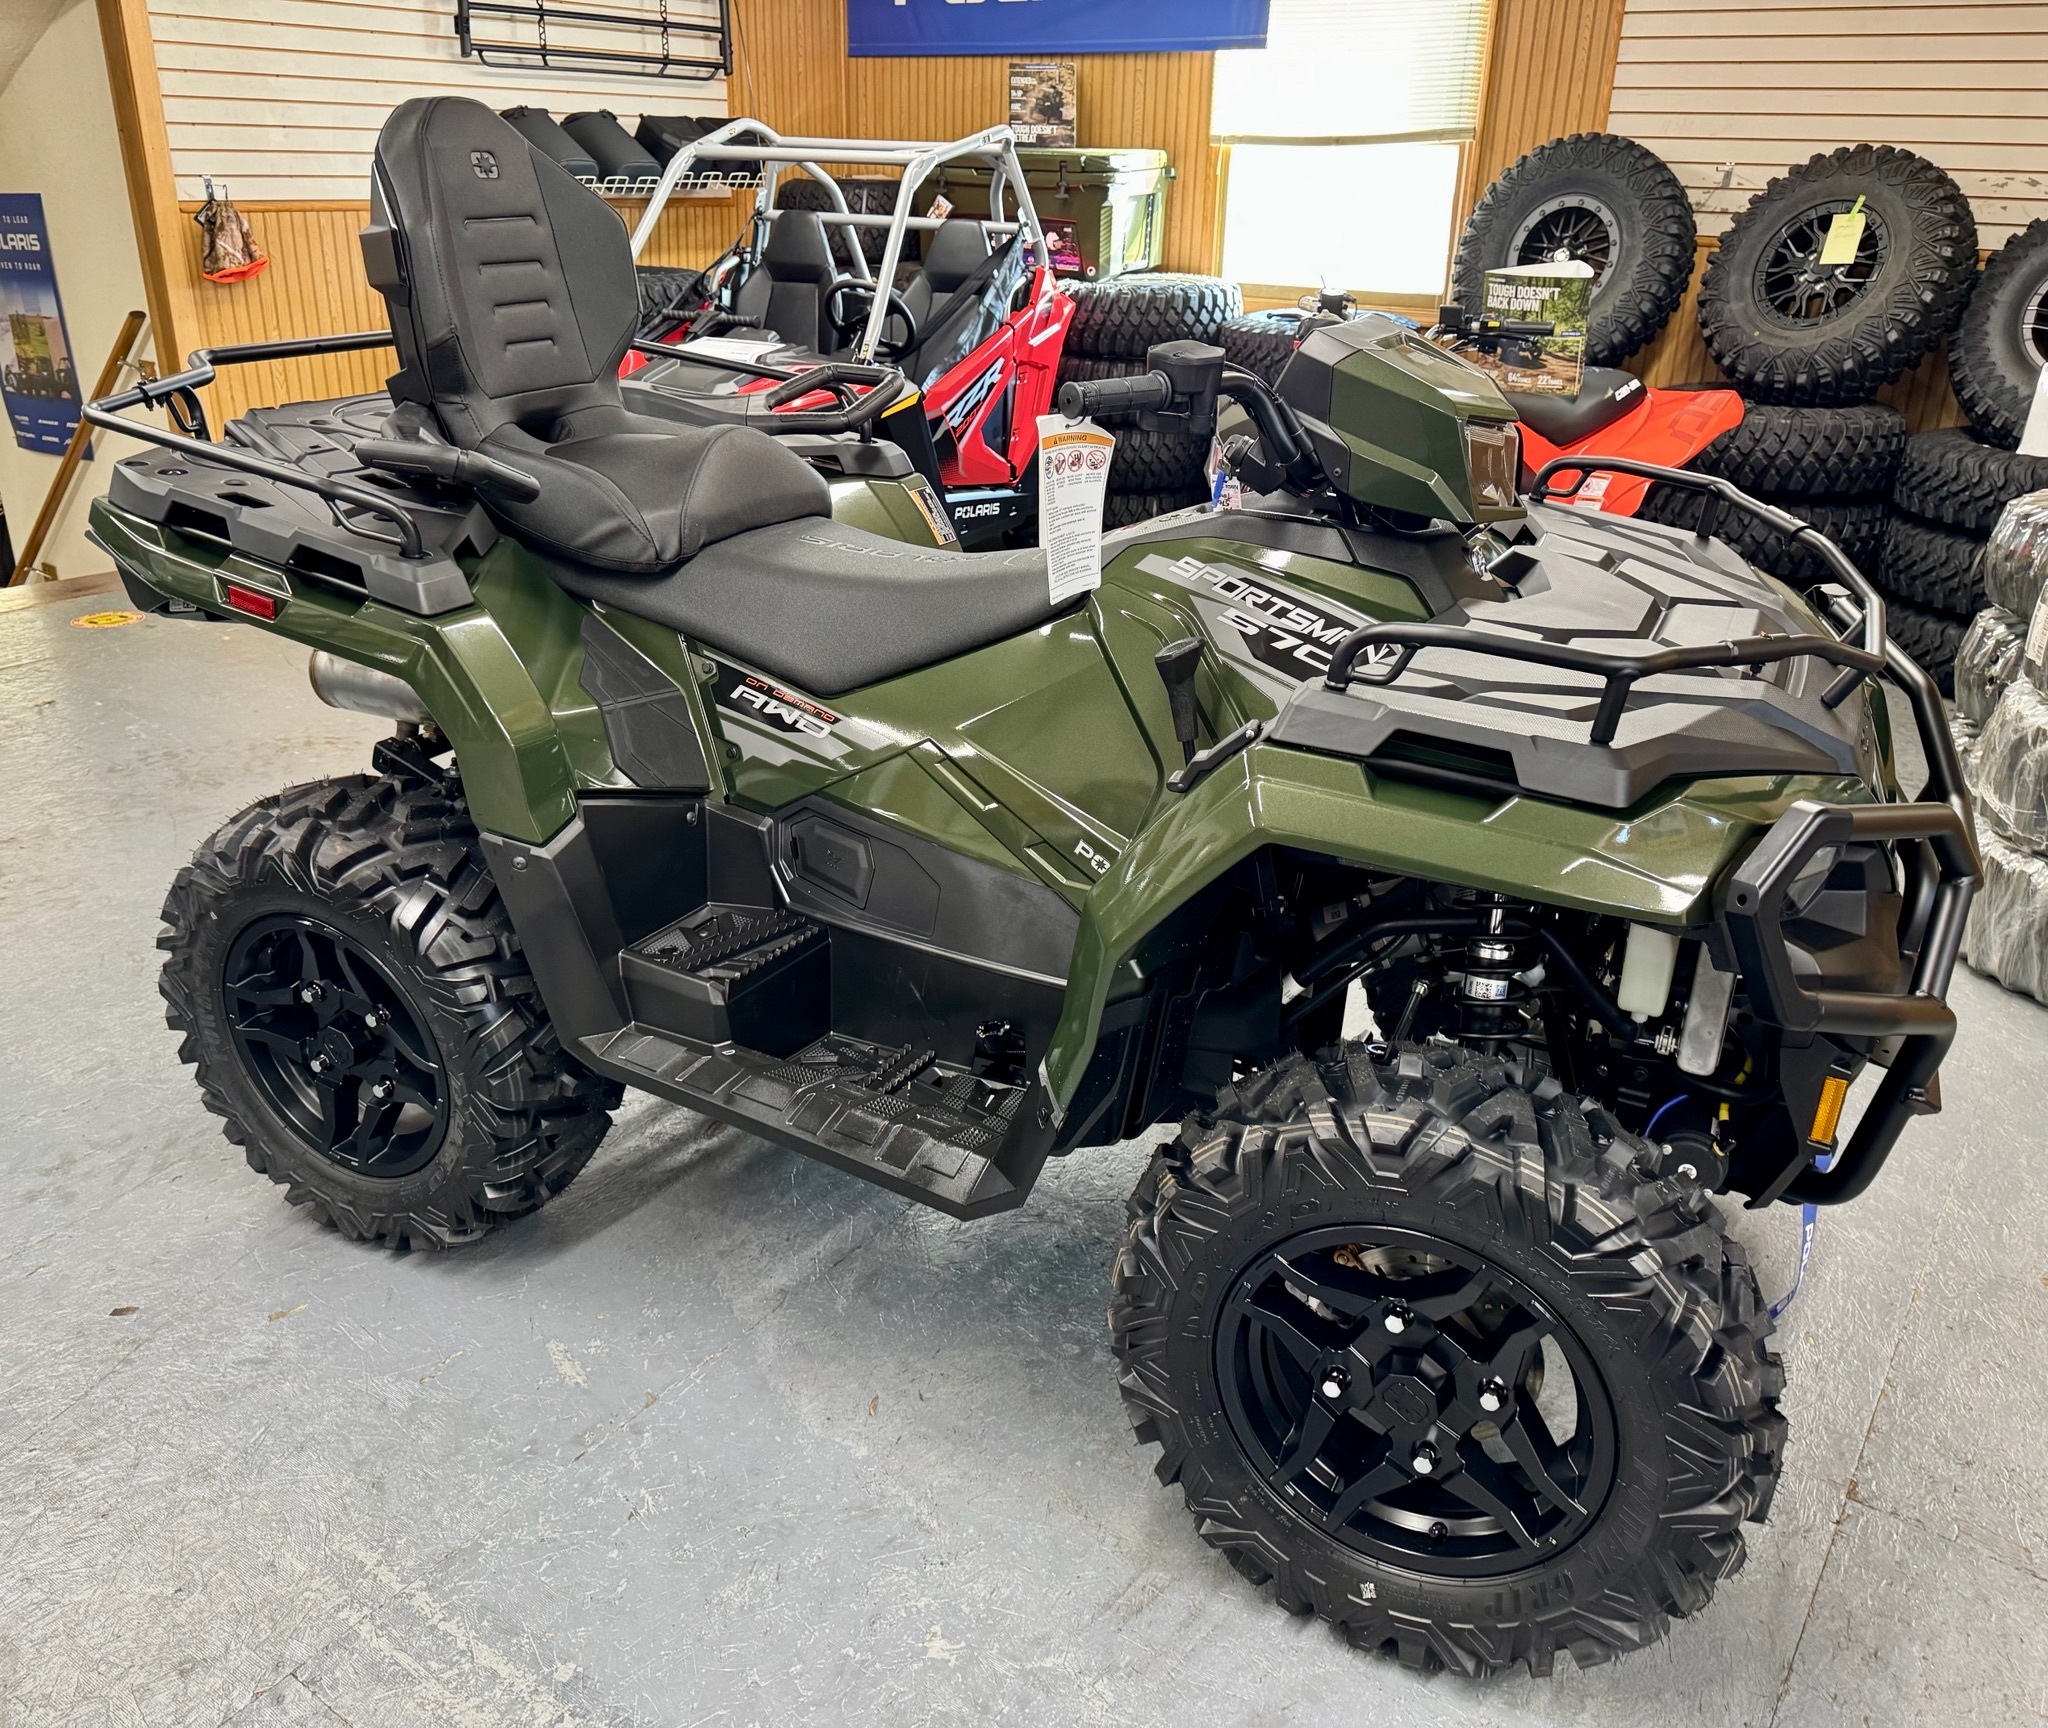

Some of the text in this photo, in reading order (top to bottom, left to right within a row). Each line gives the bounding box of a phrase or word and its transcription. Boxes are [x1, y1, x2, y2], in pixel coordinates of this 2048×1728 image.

[0, 233, 41, 251] LARIS
[1488, 283, 1562, 301] TOUGH DOESN'T
[1487, 295, 1540, 312] BACK DOWN
[946, 357, 1005, 428] RZR
[1058, 434, 1088, 443] WARNING
[954, 502, 1001, 520] POLARIS
[729, 684, 832, 740] AWD
